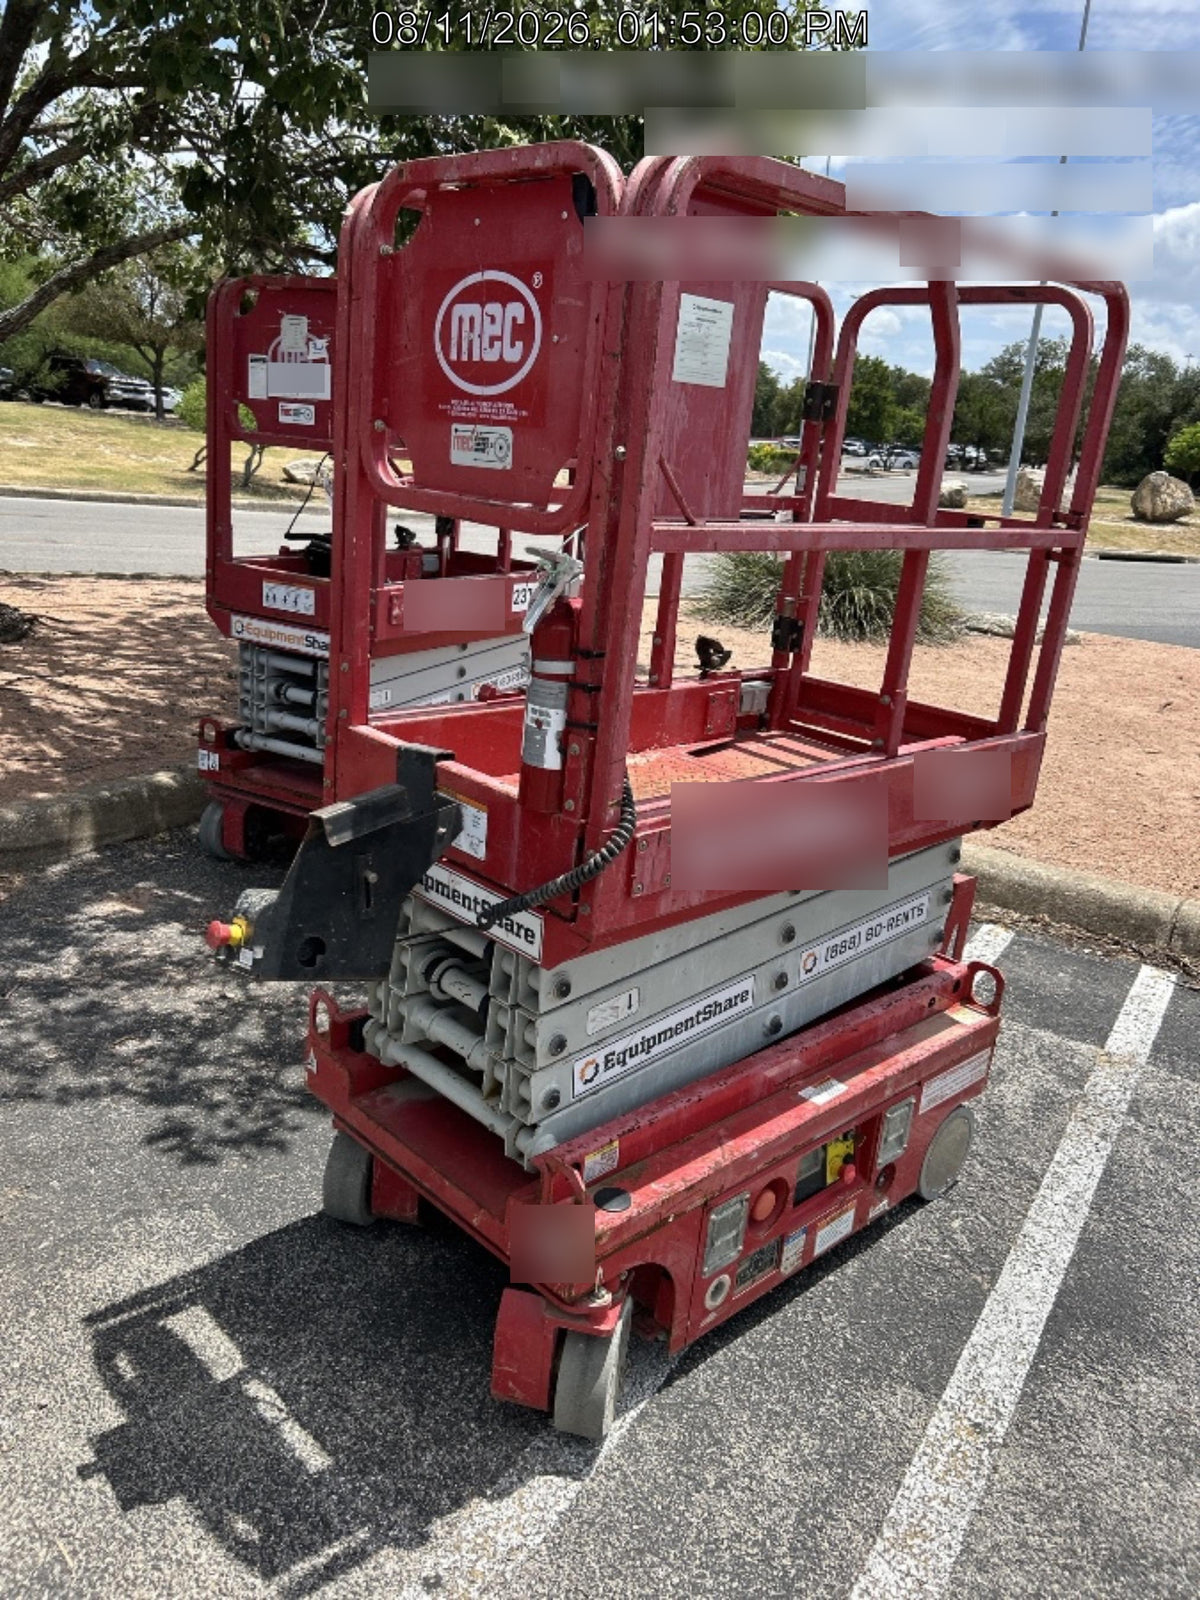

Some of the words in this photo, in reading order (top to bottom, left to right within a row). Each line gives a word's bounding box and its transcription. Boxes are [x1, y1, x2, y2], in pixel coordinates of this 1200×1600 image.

[245, 622, 329, 651] EquipmentSha
[420, 874, 536, 945] pmentSare
[824, 930, 862, 963] (888)
[603, 989, 750, 1073] EquipmentShare
